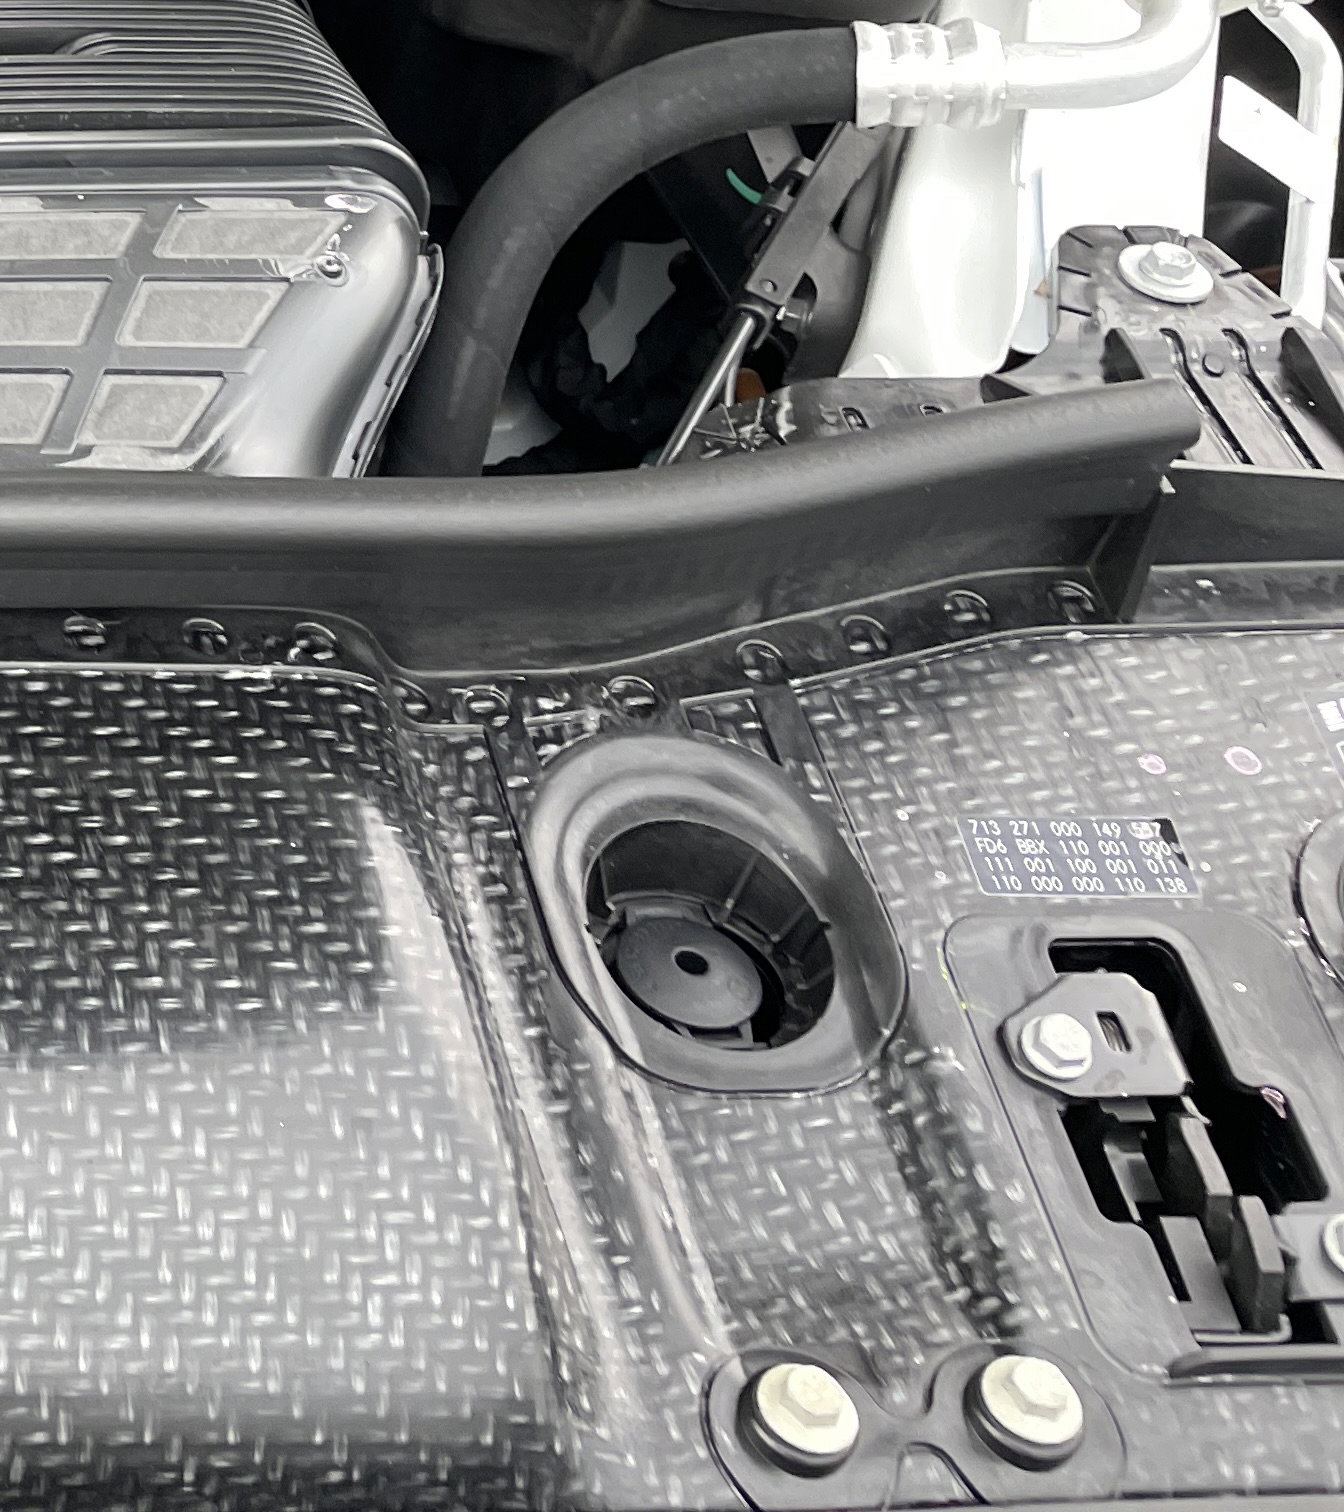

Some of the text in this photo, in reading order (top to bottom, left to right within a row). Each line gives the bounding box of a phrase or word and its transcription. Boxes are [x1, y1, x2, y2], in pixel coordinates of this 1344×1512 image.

[967, 819, 1001, 836] 713
[1009, 820, 1041, 836] 271
[1049, 821, 1082, 837] 000
[1092, 821, 1121, 839] 149
[974, 837, 1172, 856] FD6 BBX 110 001 000
[984, 856, 1179, 874] 111 001 100 001 011
[991, 875, 1188, 893] 110 000 000 110 138
